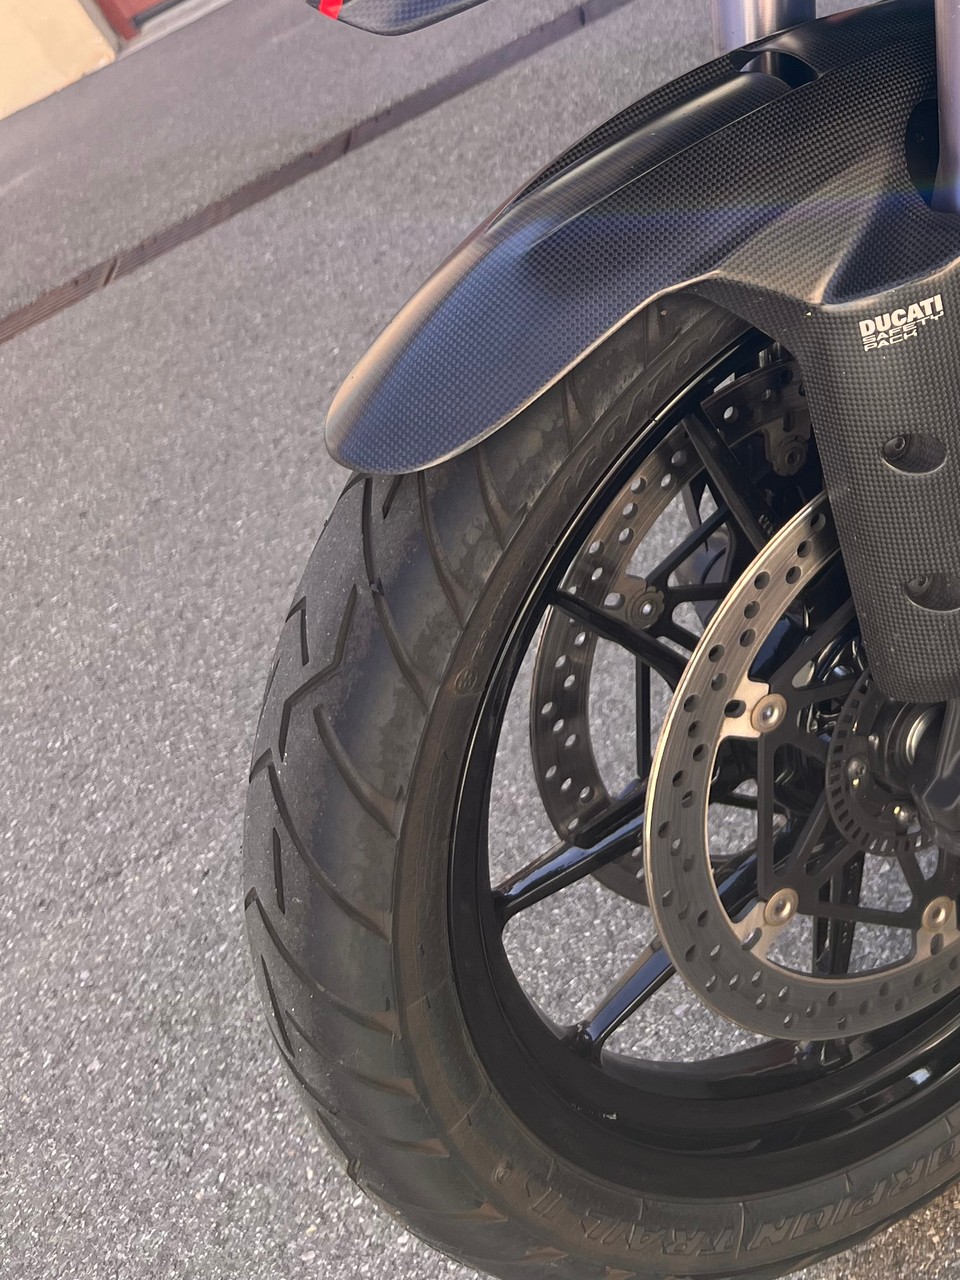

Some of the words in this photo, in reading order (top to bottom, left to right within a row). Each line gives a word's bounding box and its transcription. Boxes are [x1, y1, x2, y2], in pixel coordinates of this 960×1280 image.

[859, 293, 944, 338] DUCATI
[862, 311, 945, 345] SAFETY
[863, 328, 918, 352] PACK
[578, 1208, 736, 1258] TRAIL
